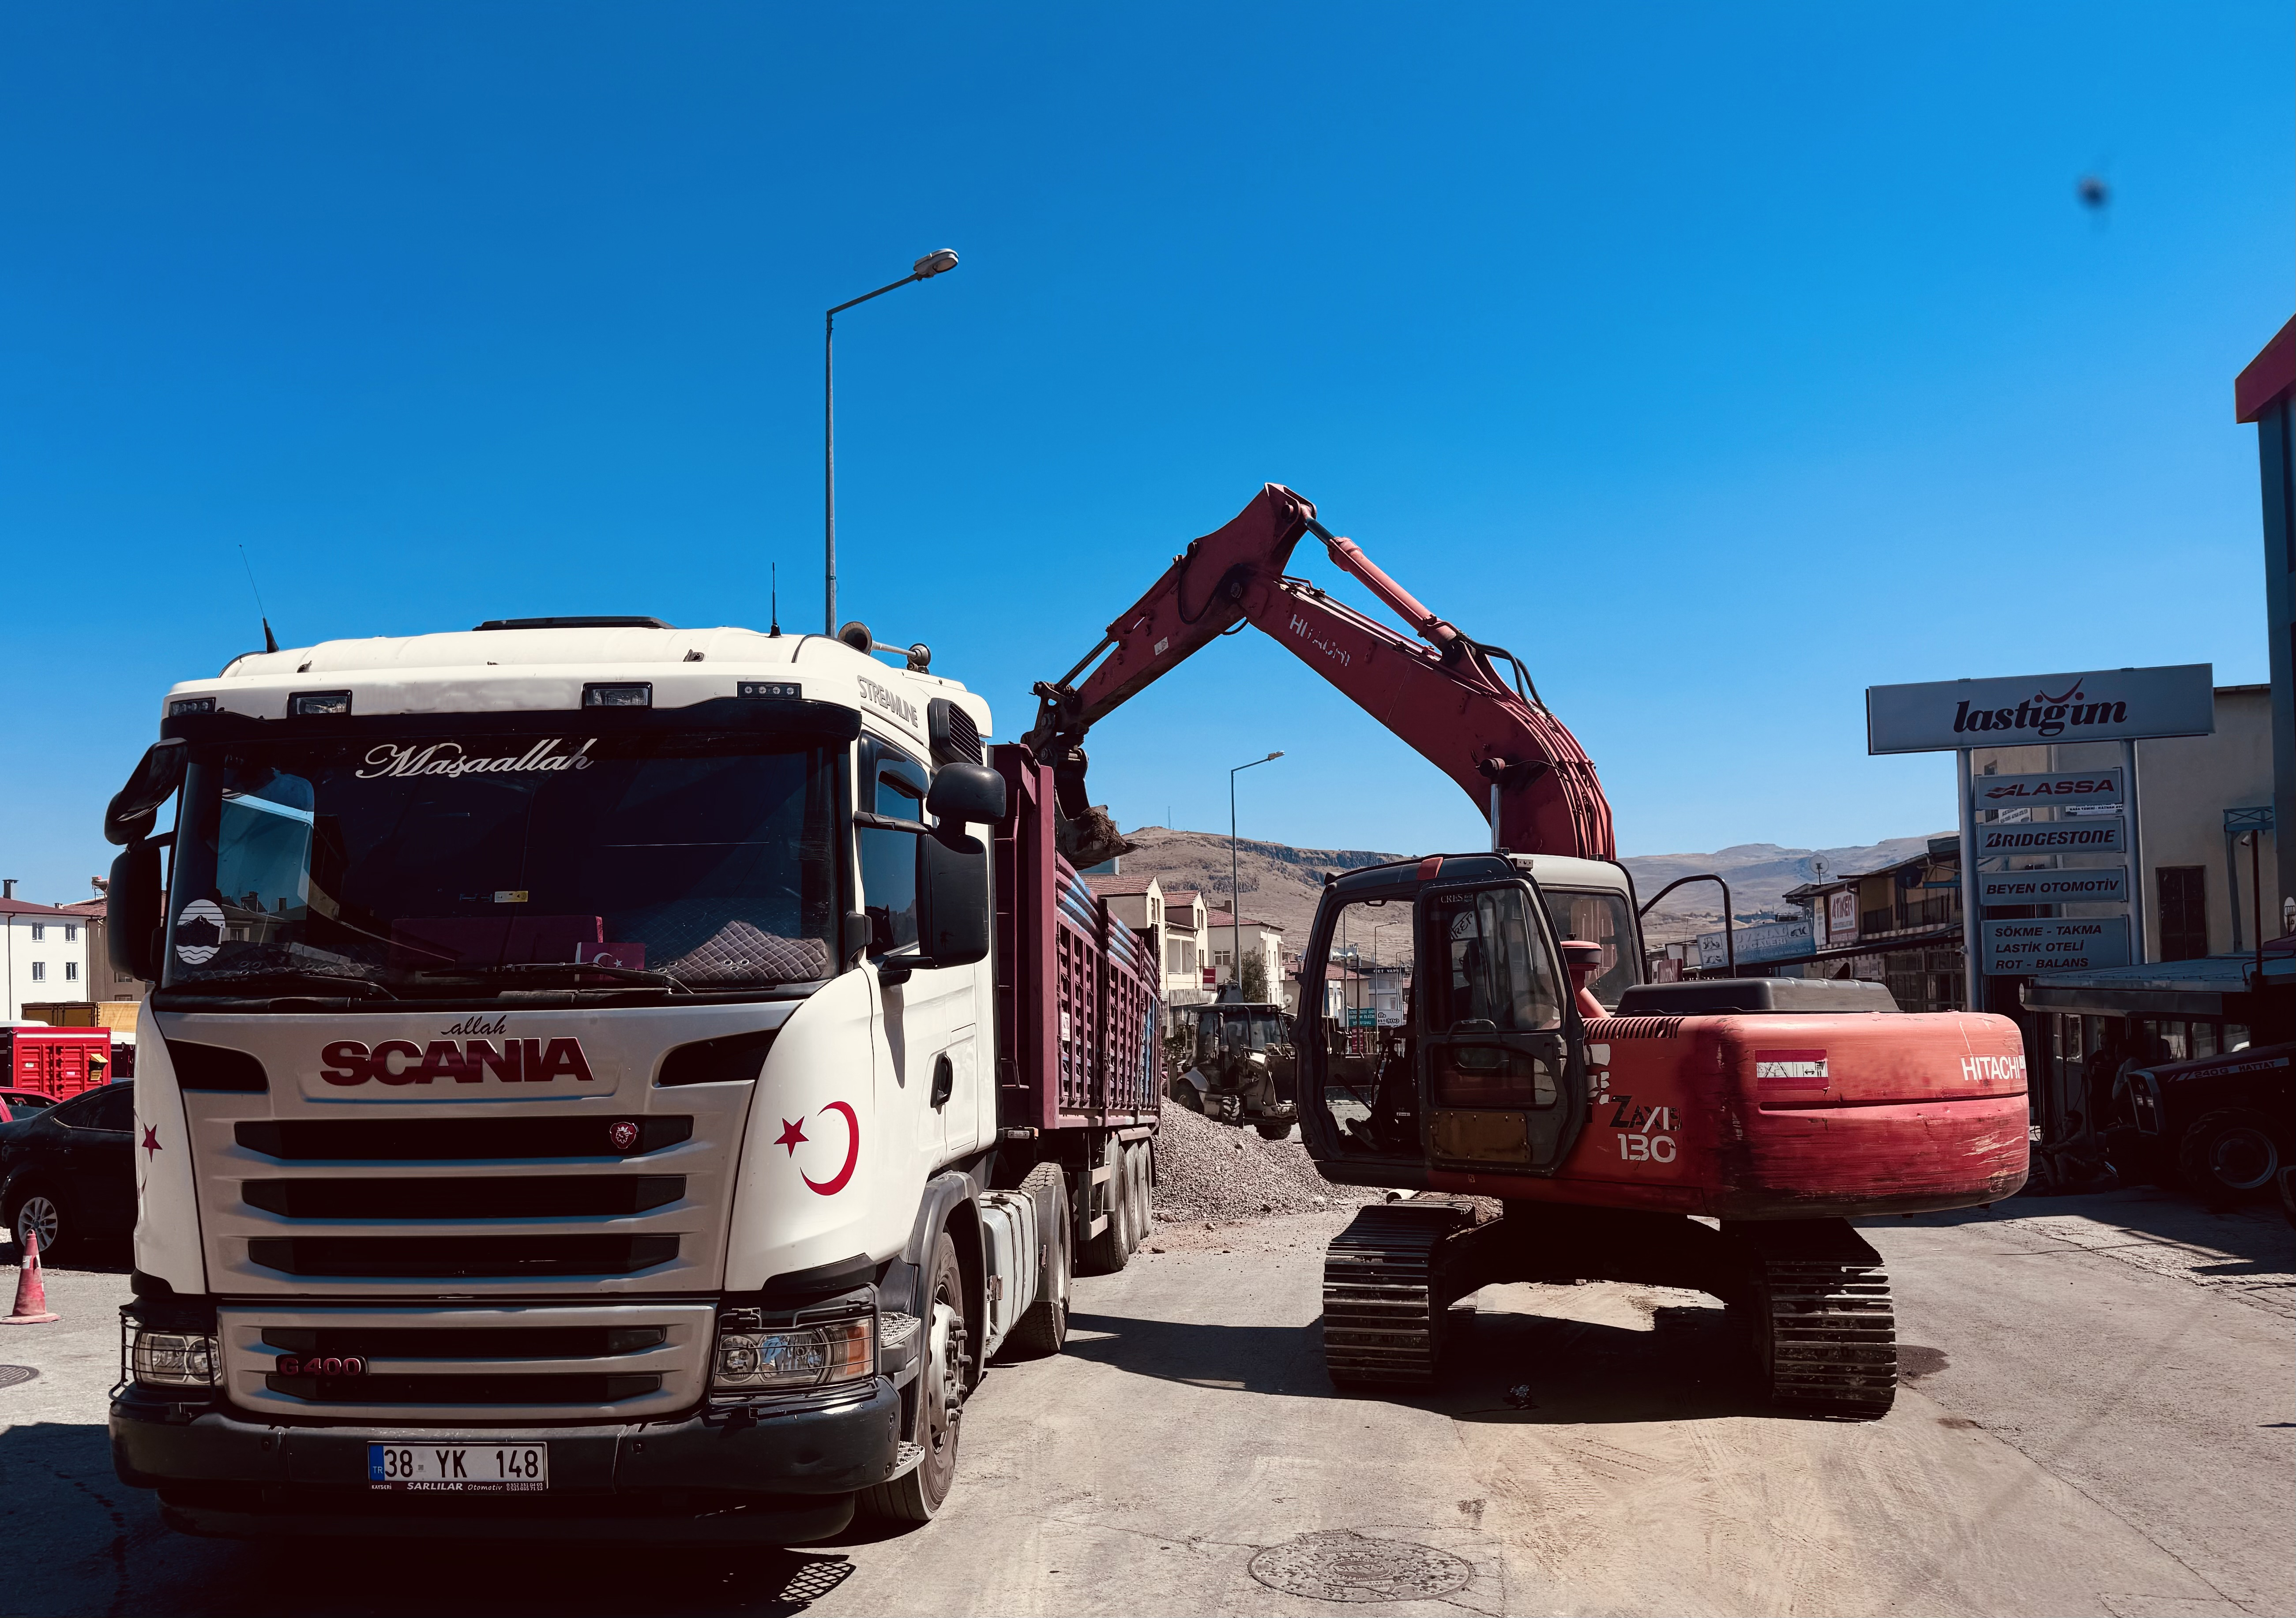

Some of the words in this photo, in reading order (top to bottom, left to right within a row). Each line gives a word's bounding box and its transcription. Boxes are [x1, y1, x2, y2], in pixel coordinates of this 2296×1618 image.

[857, 675, 919, 728] STREAMLINE
[355, 738, 597, 778] Maşaallah
[2015, 779, 2114, 796] LASSA
[1985, 830, 2115, 848] BRIDGESTONE
[1986, 883, 2036, 894] BEYEN
[2040, 879, 2119, 893] OTOMOTİV
[1995, 926, 2044, 937] SÖKME
[2056, 924, 2102, 935] TAKMA
[1995, 940, 2041, 953] LASTİK
[2045, 939, 2084, 952] OTELİ
[1995, 958, 2023, 969] ROT
[2035, 957, 2089, 969] BALANS
[440, 1015, 507, 1036] allah
[320, 1037, 594, 1086] SCANIA
[1961, 1056, 2021, 1081] HITACHI
[2238, 1061, 2275, 1072] HATTAT
[1617, 1133, 1676, 1163] 130
[280, 1358, 298, 1376] G
[303, 1357, 361, 1376] 400
[384, 1449, 413, 1478] 38
[436, 1450, 467, 1478] YK
[496, 1450, 539, 1478] 148
